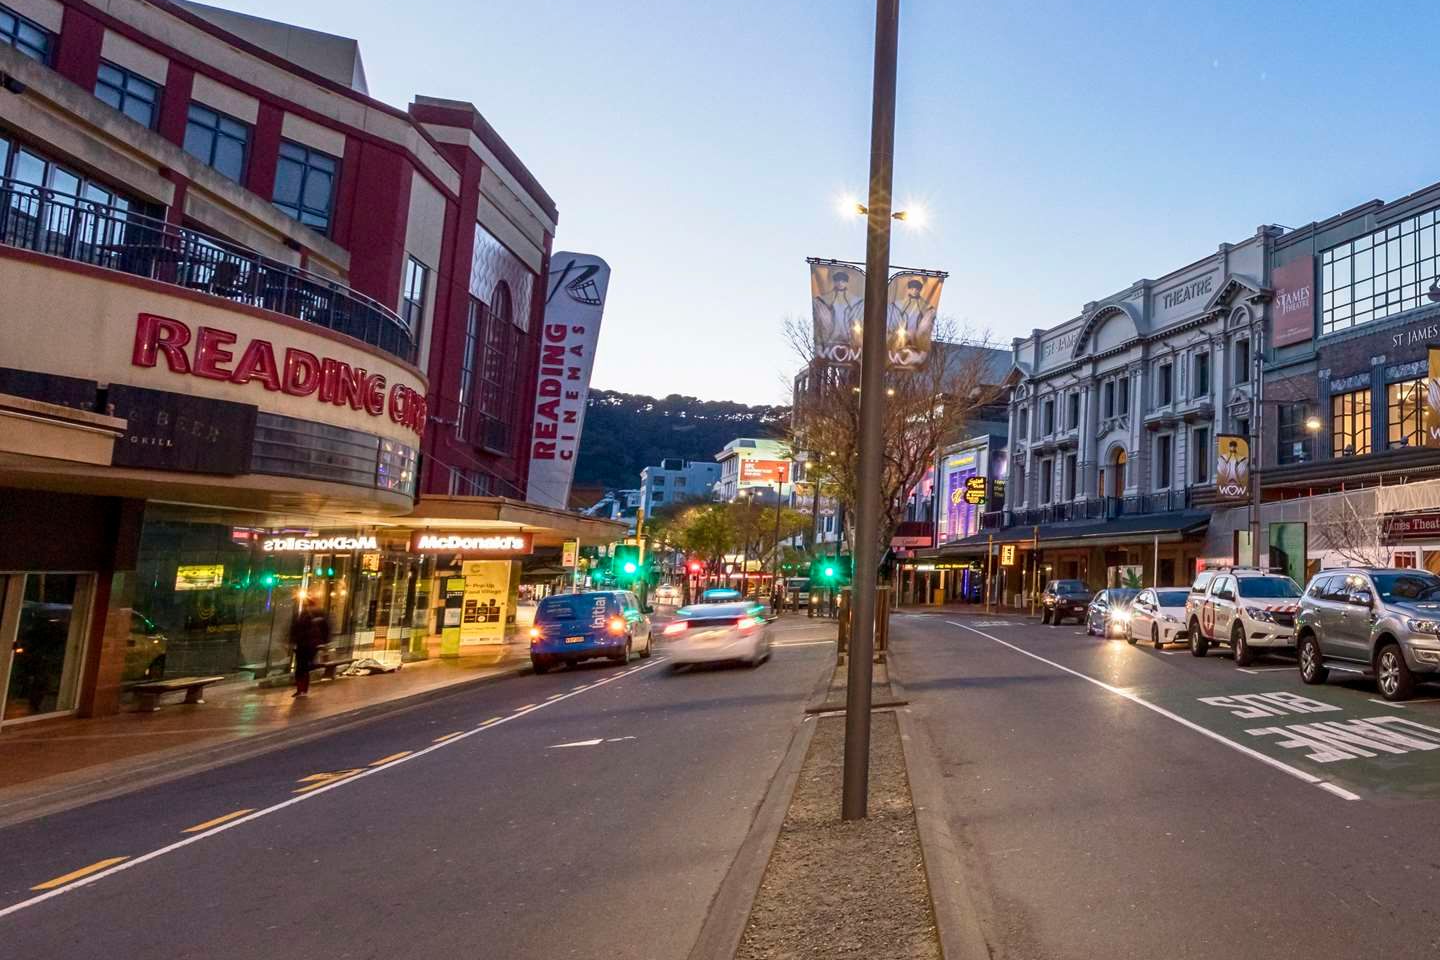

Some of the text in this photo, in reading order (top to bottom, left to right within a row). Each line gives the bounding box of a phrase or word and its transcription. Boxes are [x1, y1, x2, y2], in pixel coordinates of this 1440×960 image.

[1163, 276, 1212, 310] THEATRE
[1407, 324, 1438, 346] JAMES
[131, 312, 386, 417] READING
[532, 324, 567, 460] READING
[560, 325, 585, 460] CINEMAS
[417, 535, 525, 550] McDonald's
[1197, 691, 1344, 719] BUS
